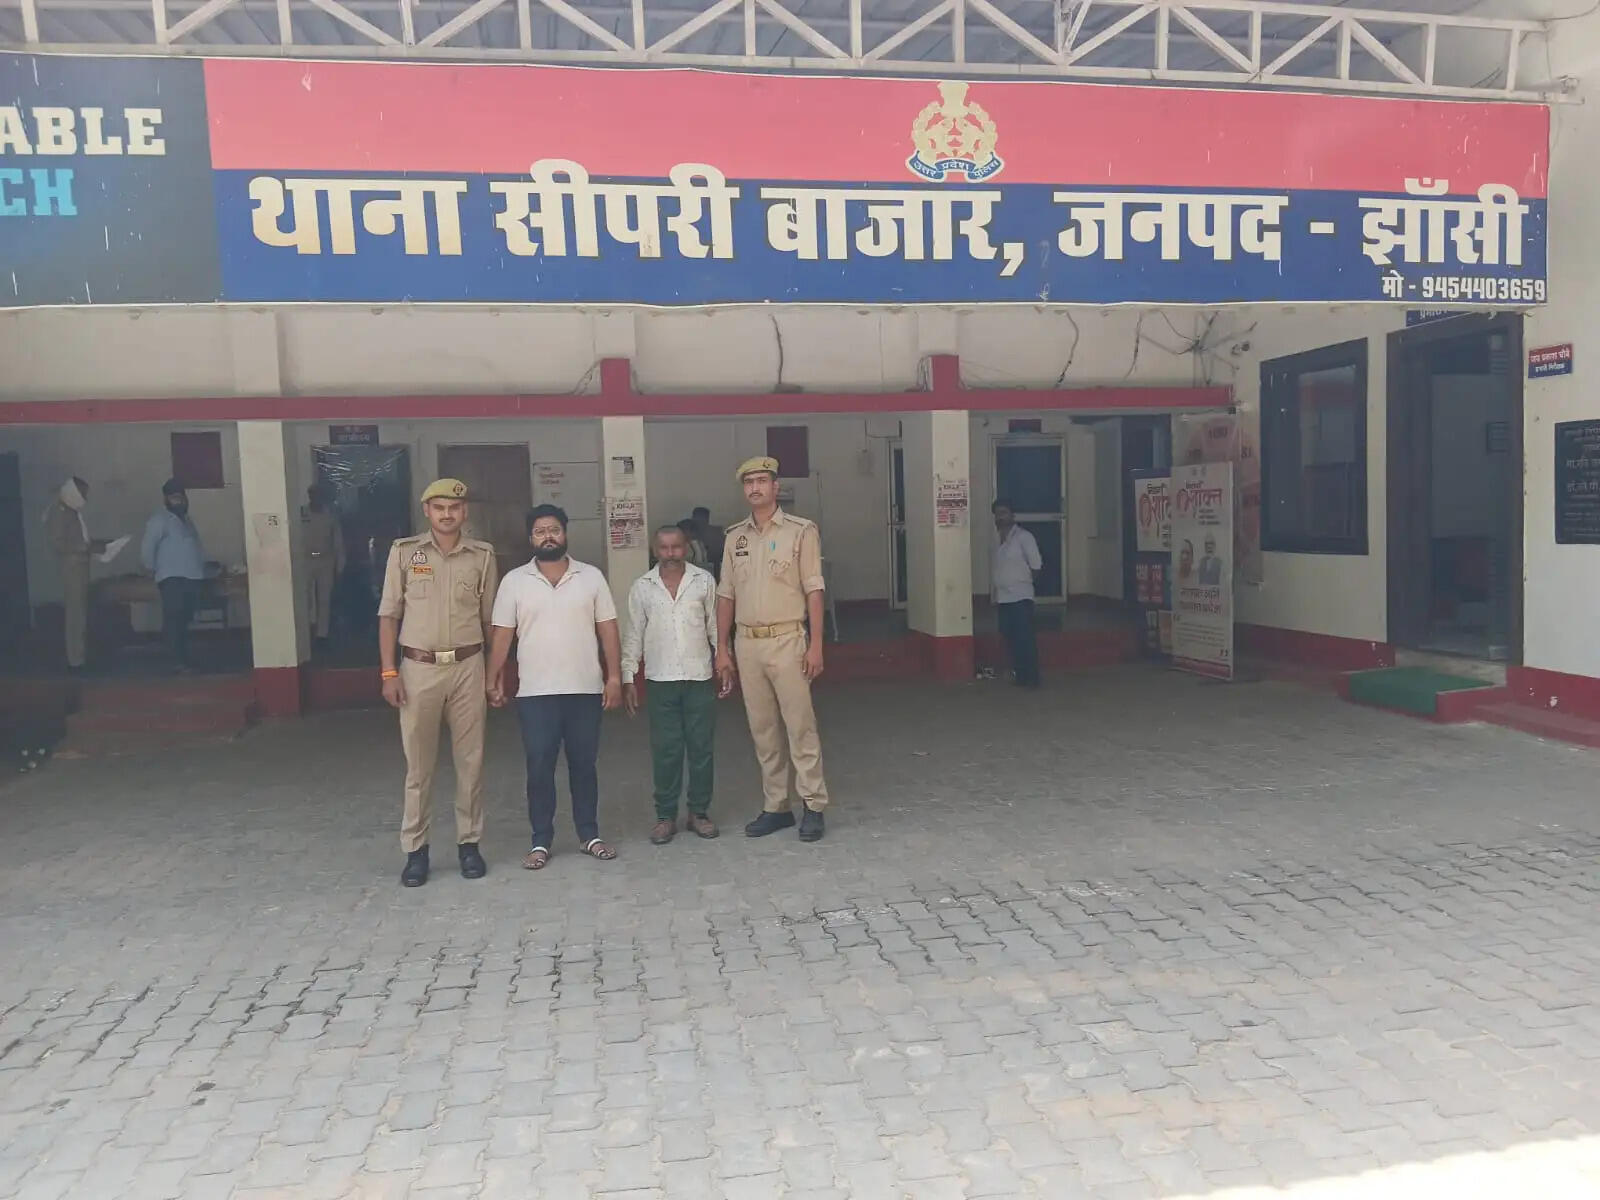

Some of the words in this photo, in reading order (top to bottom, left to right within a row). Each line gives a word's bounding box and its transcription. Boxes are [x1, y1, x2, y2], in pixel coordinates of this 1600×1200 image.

[249, 176, 467, 255] थाना
[489, 158, 740, 259] सीपरी
[760, 187, 1024, 277] बाजार,
[1053, 191, 1288, 262] जनपद
[1381, 269, 1404, 298] मो
[1422, 276, 1546, 301] 9454403659
